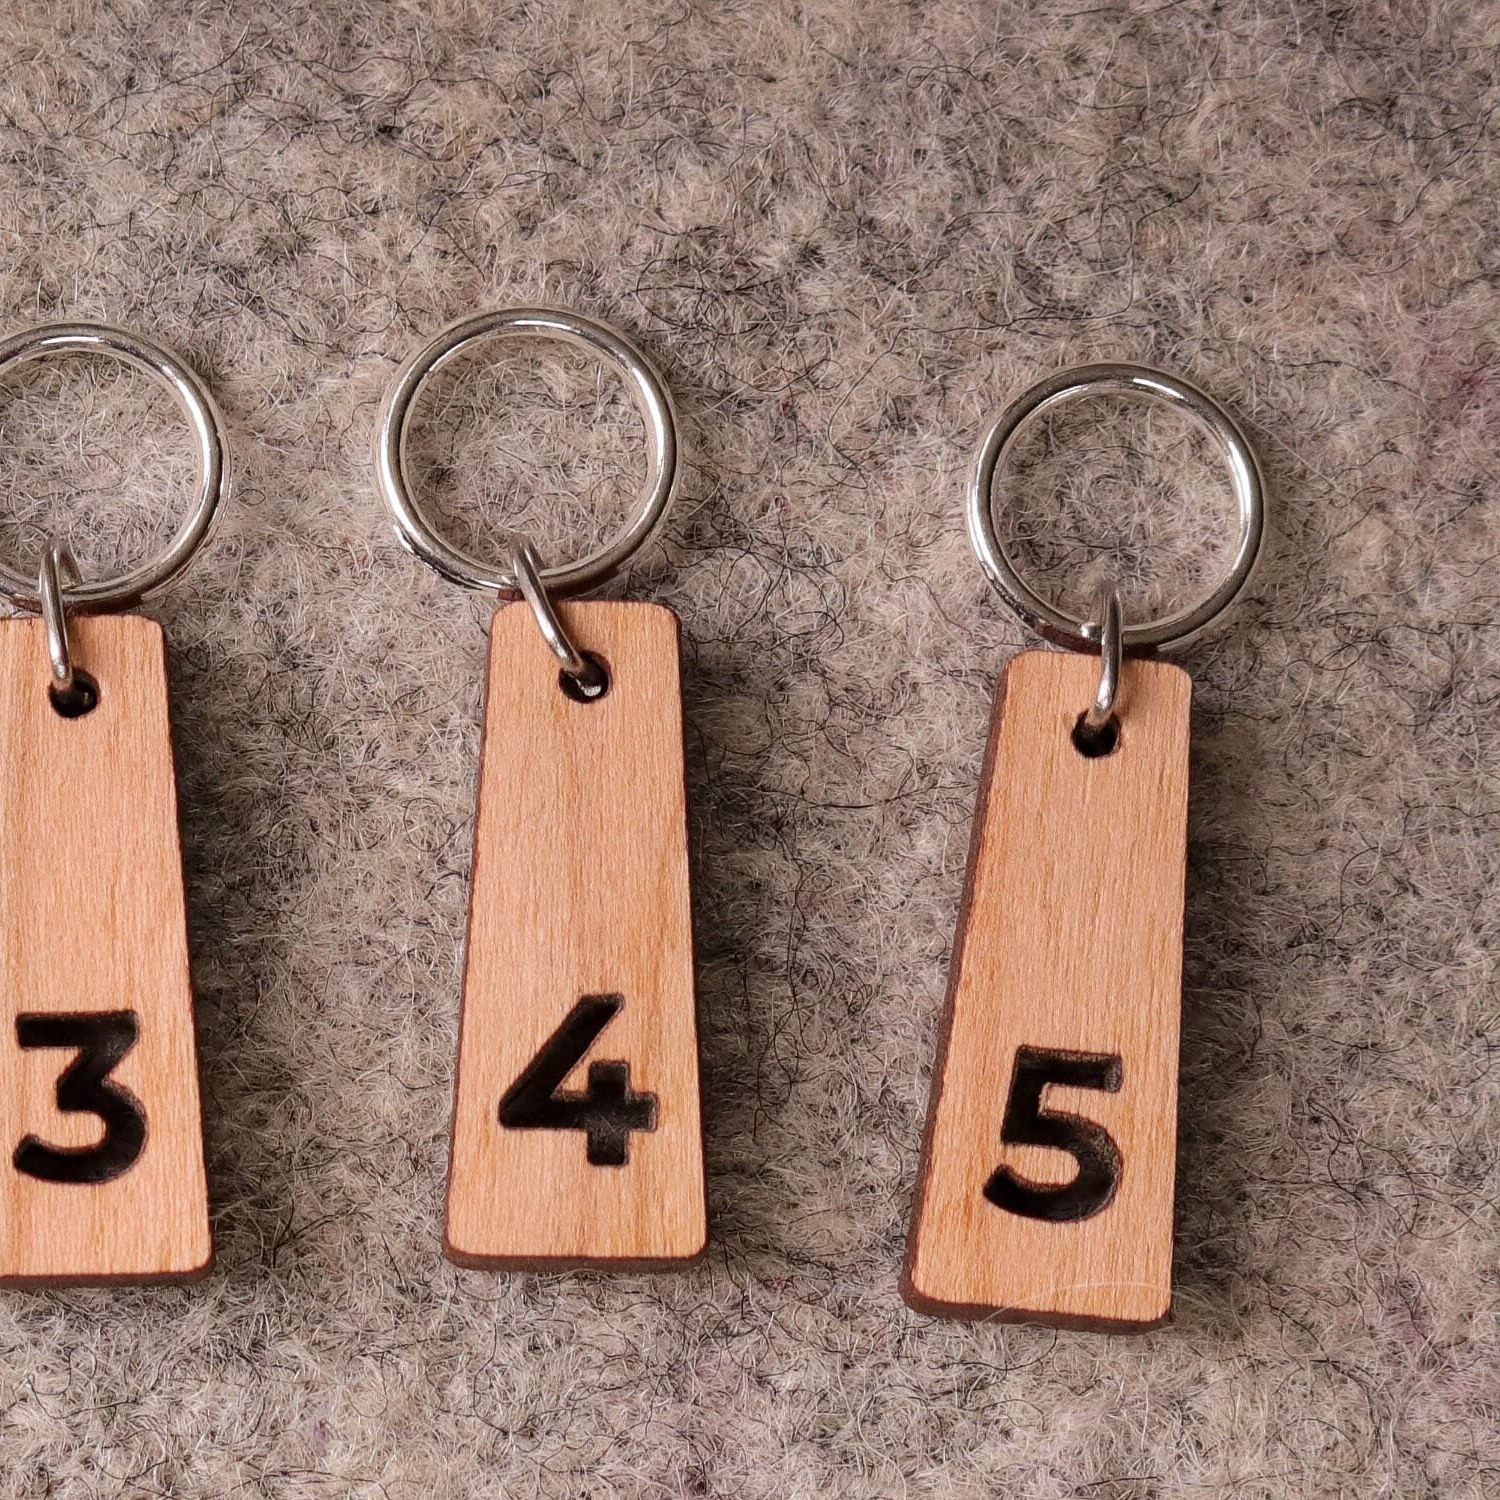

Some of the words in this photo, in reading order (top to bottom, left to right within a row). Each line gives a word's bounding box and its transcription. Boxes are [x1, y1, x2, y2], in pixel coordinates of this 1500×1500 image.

[12, 1009, 147, 1185] 3
[498, 993, 658, 1168] 4
[982, 1044, 1124, 1224] 5
